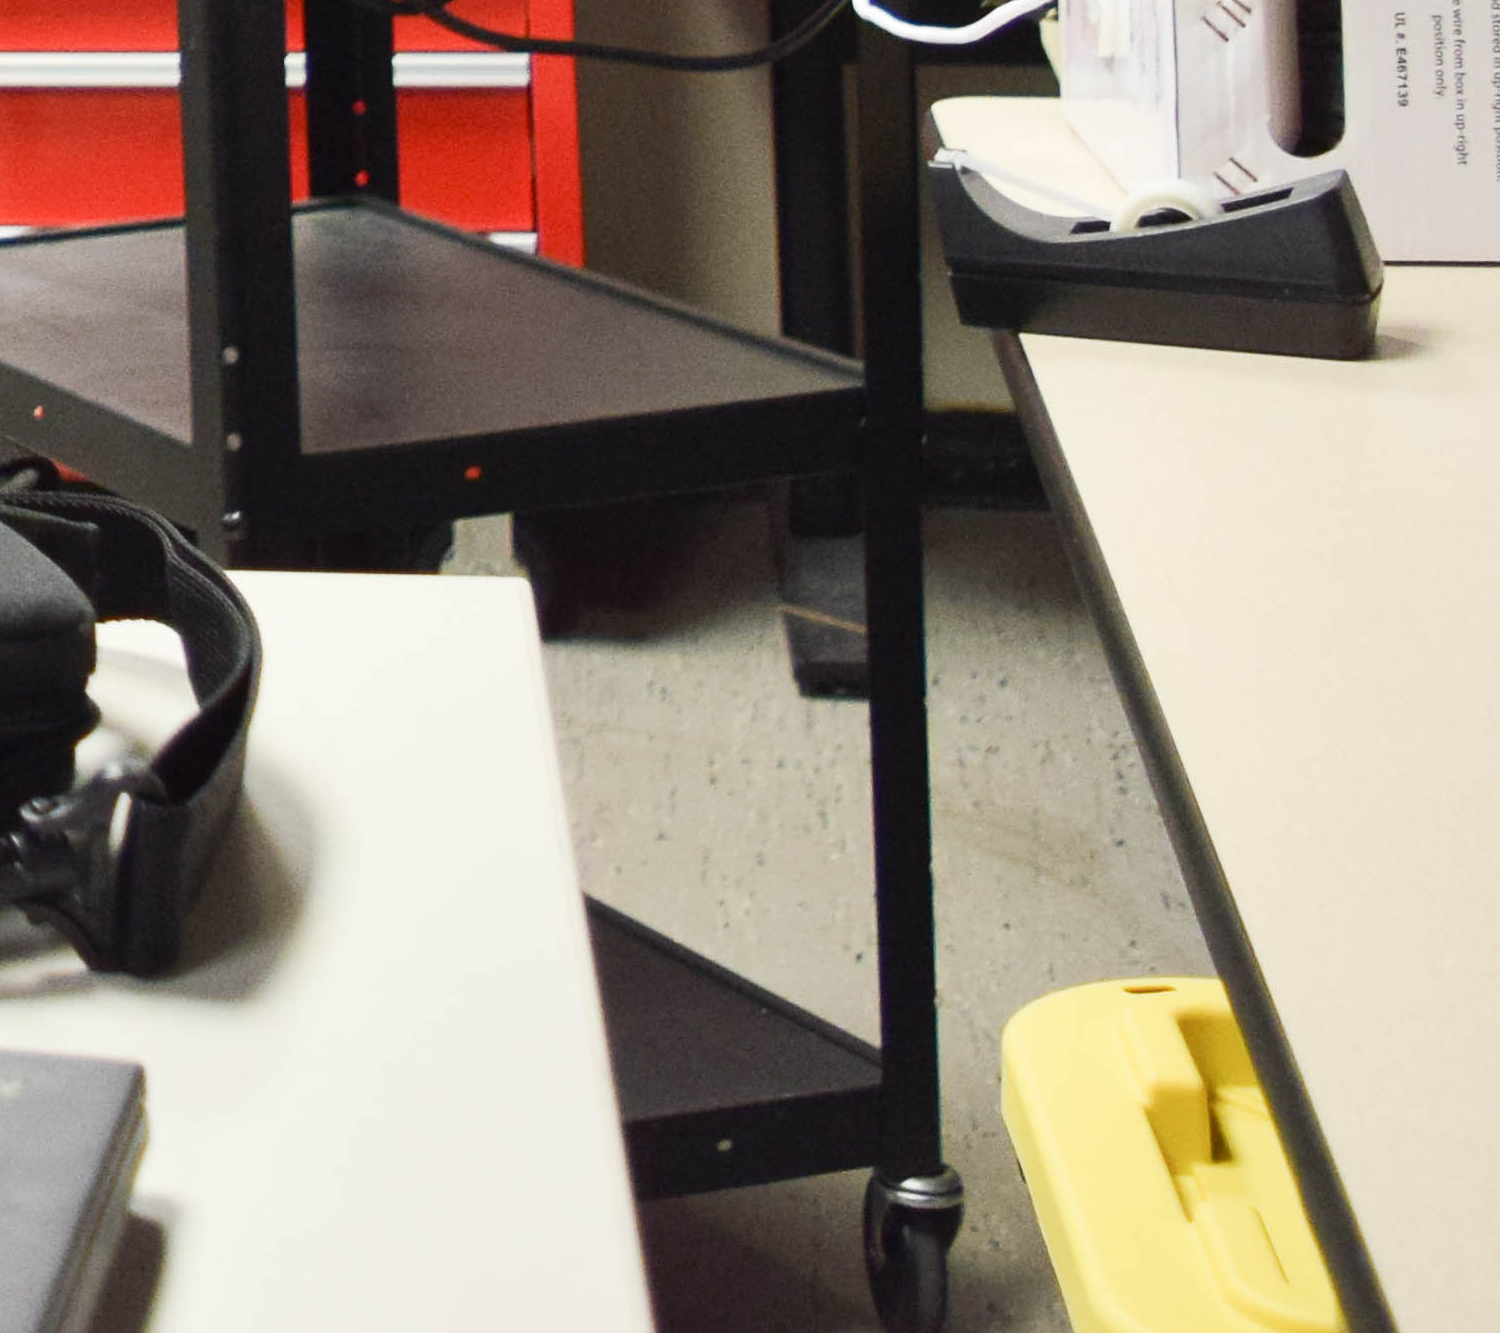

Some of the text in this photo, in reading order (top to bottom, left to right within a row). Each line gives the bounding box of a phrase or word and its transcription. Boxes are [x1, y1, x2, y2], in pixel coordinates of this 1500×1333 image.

[1394, 11, 1406, 29] UL
[1452, 8, 1463, 36] wire
[1431, 13, 1445, 66] position
[1453, 38, 1465, 70] from
[1454, 71, 1467, 96] box
[1456, 98, 1467, 111] in
